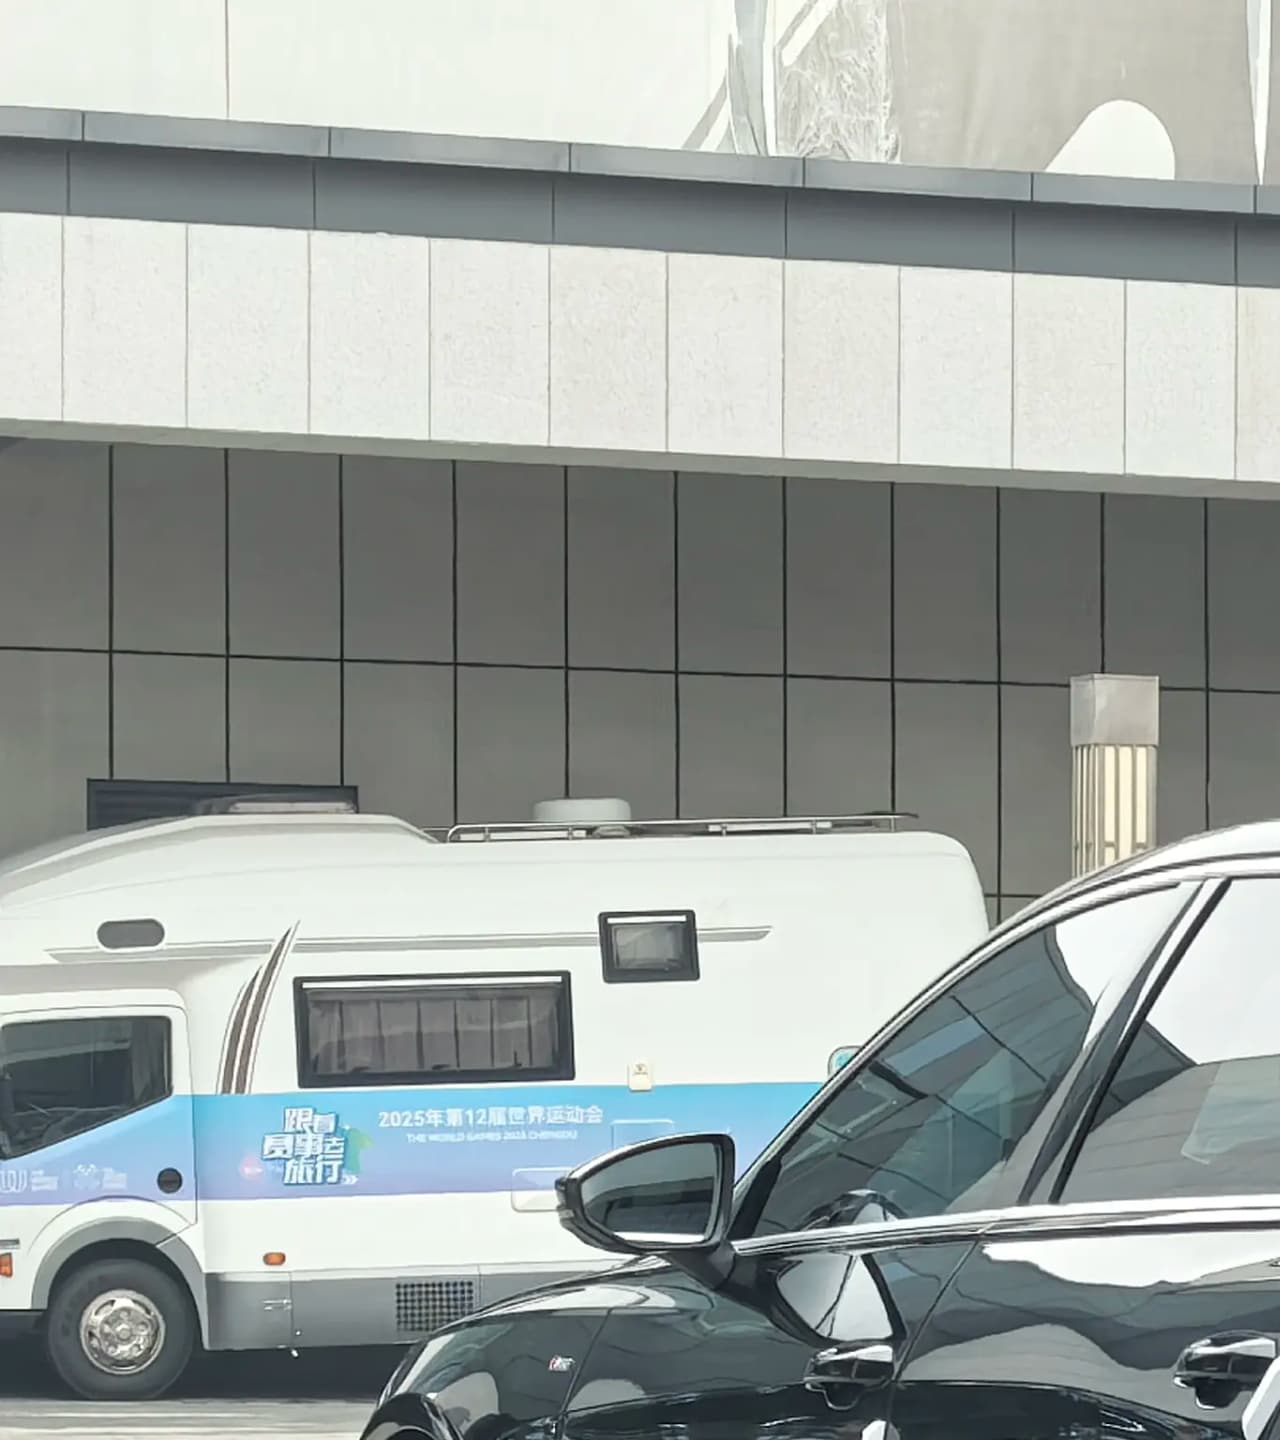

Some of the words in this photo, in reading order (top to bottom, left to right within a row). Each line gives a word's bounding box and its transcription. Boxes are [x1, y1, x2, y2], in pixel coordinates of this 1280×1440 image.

[378, 1105, 604, 1128] 2025年第12届世界运动会
